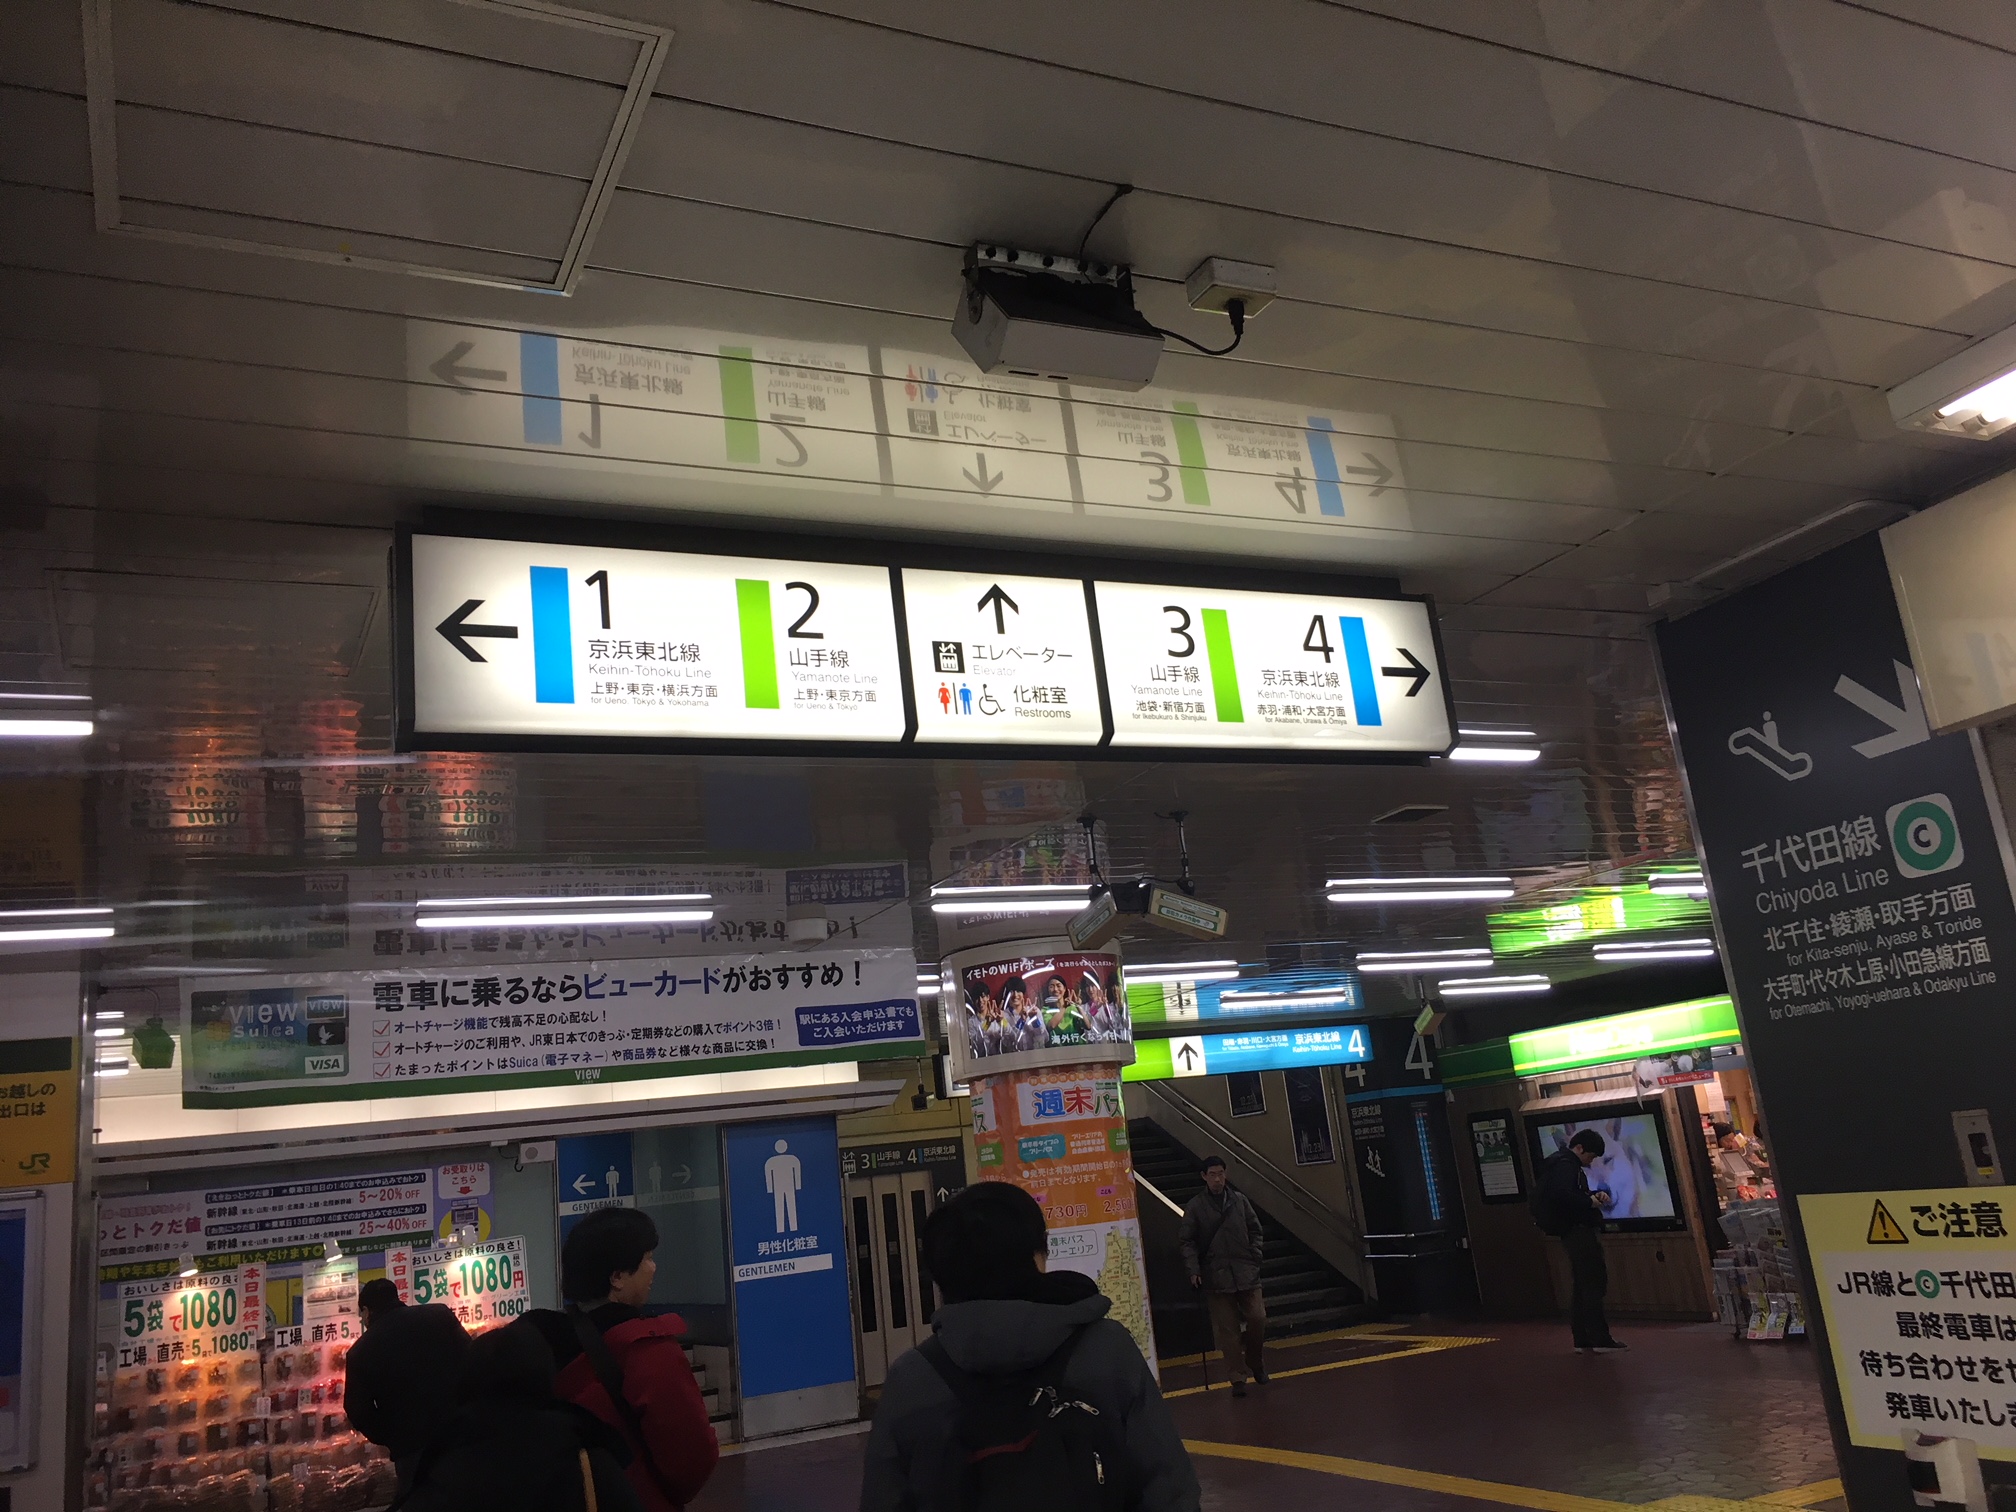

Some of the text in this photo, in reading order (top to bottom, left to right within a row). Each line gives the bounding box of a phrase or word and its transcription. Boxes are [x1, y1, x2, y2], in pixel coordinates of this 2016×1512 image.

[585, 570, 610, 629] 1
[785, 581, 824, 639] 2
[1162, 605, 1195, 658] 3
[1302, 614, 1334, 664] 4
[588, 639, 701, 663] 京浜東北線
[789, 647, 850, 669] 山手線
[972, 645, 1073, 663] エレベーター
[685, 667, 712, 679] Line
[791, 671, 878, 684] Yamanote Line
[973, 665, 1016, 676] Elevator
[1150, 664, 1201, 683] 山手線
[1261, 669, 1341, 689] 京浜東北線
[591, 682, 718, 698] 上野・東京・横浜方面
[794, 688, 877, 702] 上野・東京方面
[1013, 685, 1068, 704] 化粧室
[1130, 684, 1203, 697] Yamanote Line
[1324, 691, 1343, 701] Line
[667, 699, 709, 707] Yokohama
[1015, 707, 1072, 719] Restrooms
[1135, 700, 1206, 714] 池袋・新宿方面
[1257, 704, 1346, 718] 赤羽・浦和・大宮方面
[1142, 713, 1173, 721] Ikebukuro
[1181, 714, 1207, 722] Shinjuku
[1740, 814, 1932, 884] 千代田線 C
[1755, 868, 1889, 914] Chiyoda Line
[1763, 882, 1977, 952] 北千住・綾瀬・取手方面
[1786, 915, 1983, 967] for Kita-senju, Ayase & Toride
[1763, 936, 1992, 1002] 大手町・代々木上原・小田急線方面
[1769, 1006, 1783, 1020] for
[1835, 986, 1911, 1009] Yoyogi-uehara
[1913, 982, 1922, 996] &
[1924, 975, 1968, 996] Odakyu
[1971, 970, 1997, 986] Line
[799, 1005, 914, 1025] 駅にある入会申込書でも
[812, 1019, 905, 1039] ご入会いただけます
[1294, 1031, 1341, 1045] 京浜東北線
[1347, 1028, 1366, 1058] 4
[1330, 1043, 1342, 1051] Line
[310, 1058, 340, 1070] VISA
[19, 1152, 51, 1170] JR
[860, 1153, 870, 1169] 3
[876, 1150, 901, 1162] 山手線
[907, 1148, 918, 1164] 4
[442, 1163, 485, 1175] お受取りは
[452, 1175, 477, 1185] こちら
[206, 1205, 238, 1219] 新幹線
[405, 1190, 421, 1199] OFF
[572, 1199, 623, 1212] GENTLEMEN
[1910, 1201, 2008, 1239] ご注意
[206, 1238, 238, 1251] 新幹線
[412, 1219, 427, 1229] OFF
[757, 1235, 819, 1256] 男性化粧室
[738, 1262, 796, 1278] GENTLEMEN
[276, 1322, 338, 1349] 工場 直売
[1895, 1311, 2016, 1342] 最終電車は
[119, 1345, 147, 1368] 工場
[157, 1341, 184, 1364] 直売
